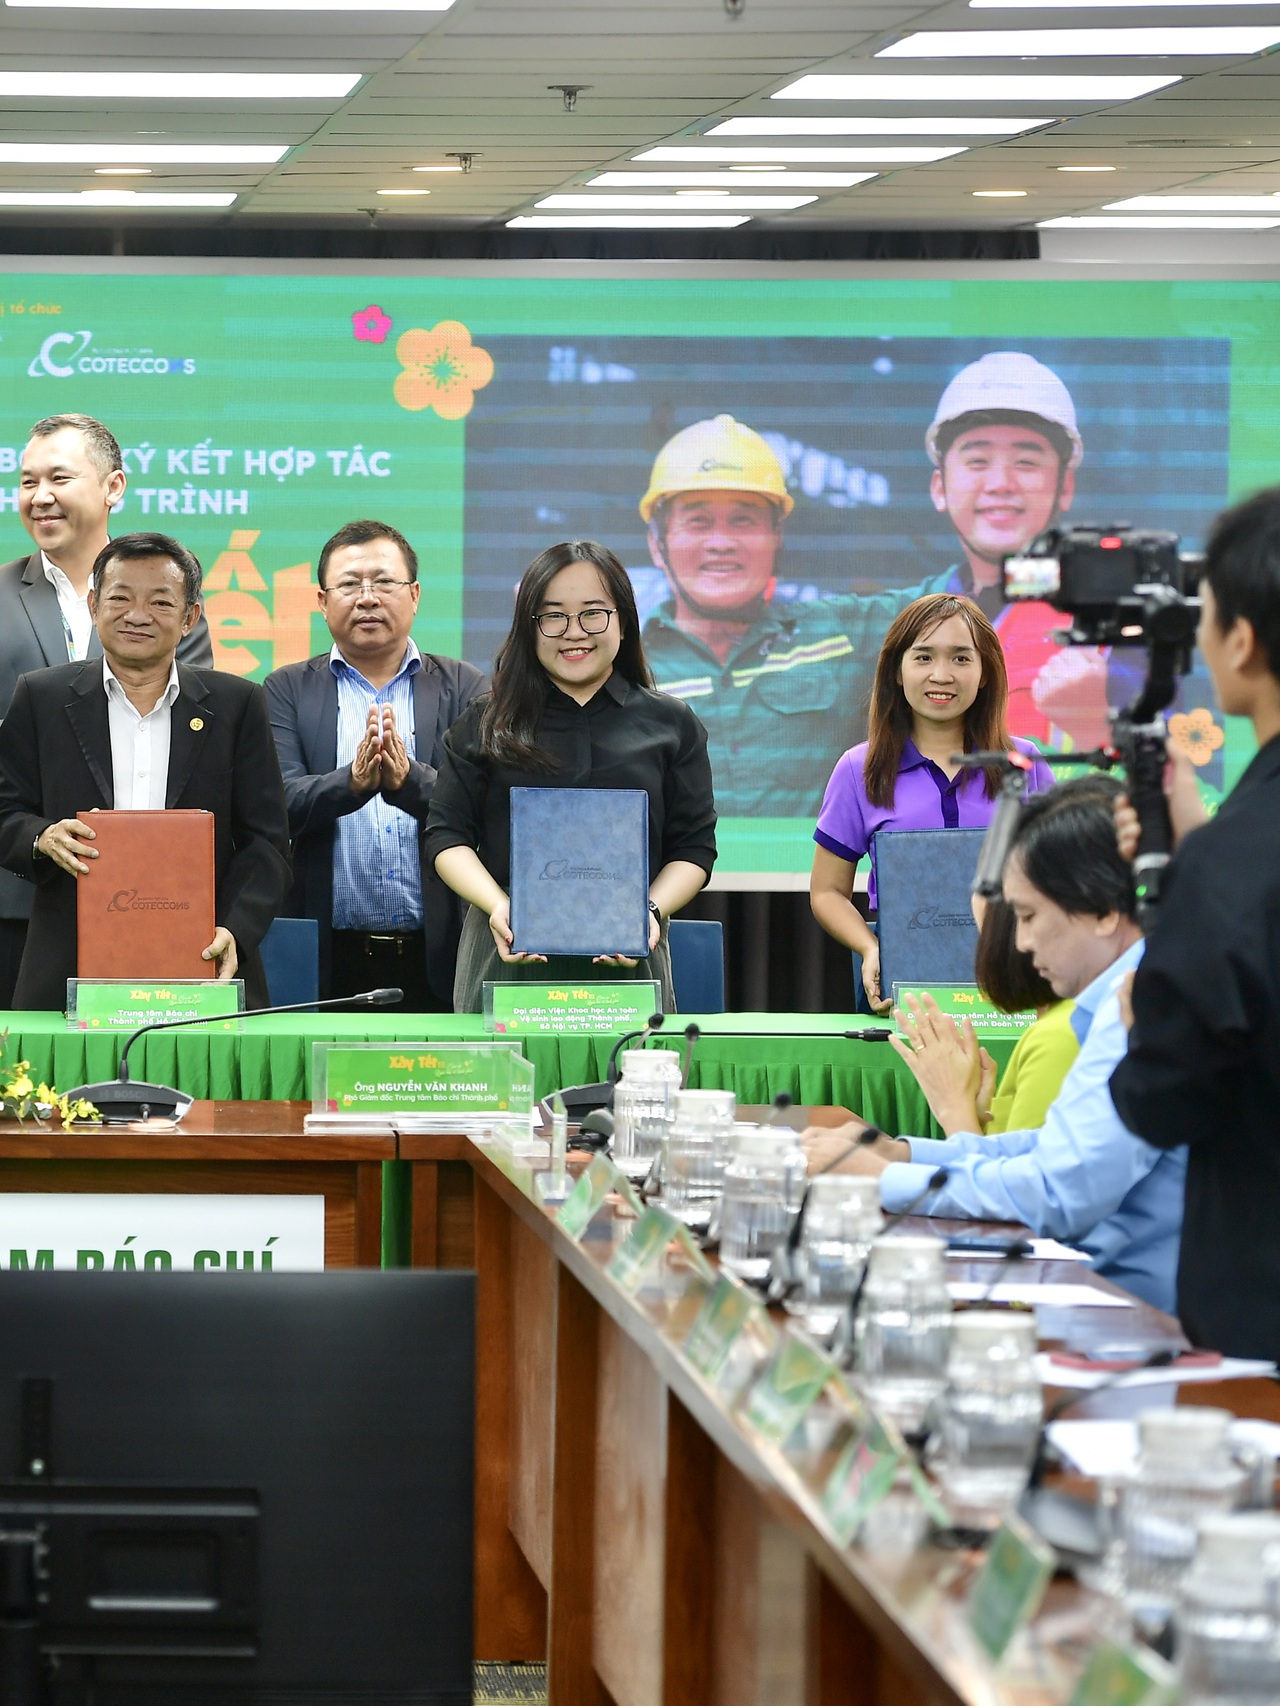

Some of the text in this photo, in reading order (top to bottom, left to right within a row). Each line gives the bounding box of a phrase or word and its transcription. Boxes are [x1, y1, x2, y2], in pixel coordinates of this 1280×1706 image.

[168, 438, 233, 475] KẾT
[245, 446, 316, 483] HỢP
[327, 443, 391, 477] TÁC
[135, 482, 249, 515] TRÌNH
[130, 988, 172, 1002] Xây Tết
[547, 988, 590, 1002] Xây Tết
[953, 993, 974, 1004] Xây
[118, 1009, 197, 1018] Trung tâm Báo chí
[513, 1007, 527, 1015] Đại
[529, 1006, 546, 1015] diện
[548, 1006, 566, 1015] Viện
[591, 1007, 605, 1015] học
[108, 1016, 136, 1025] Thành
[138, 1016, 154, 1026] phố
[520, 1015, 530, 1023] Vệ
[565, 1015, 585, 1023] động
[588, 1014, 612, 1022] Thành
[552, 1022, 566, 1030] Nội
[389, 1054, 438, 1071] Xây Tết
[354, 1079, 488, 1093] Ông NGUYỄN VĂN KHANH
[359, 1094, 378, 1102] Giám
[380, 1093, 393, 1102] đốc
[395, 1094, 415, 1102] Trung
[433, 1094, 448, 1102] Báo
[462, 1093, 483, 1102] Thành
[484, 1093, 499, 1103] phố
